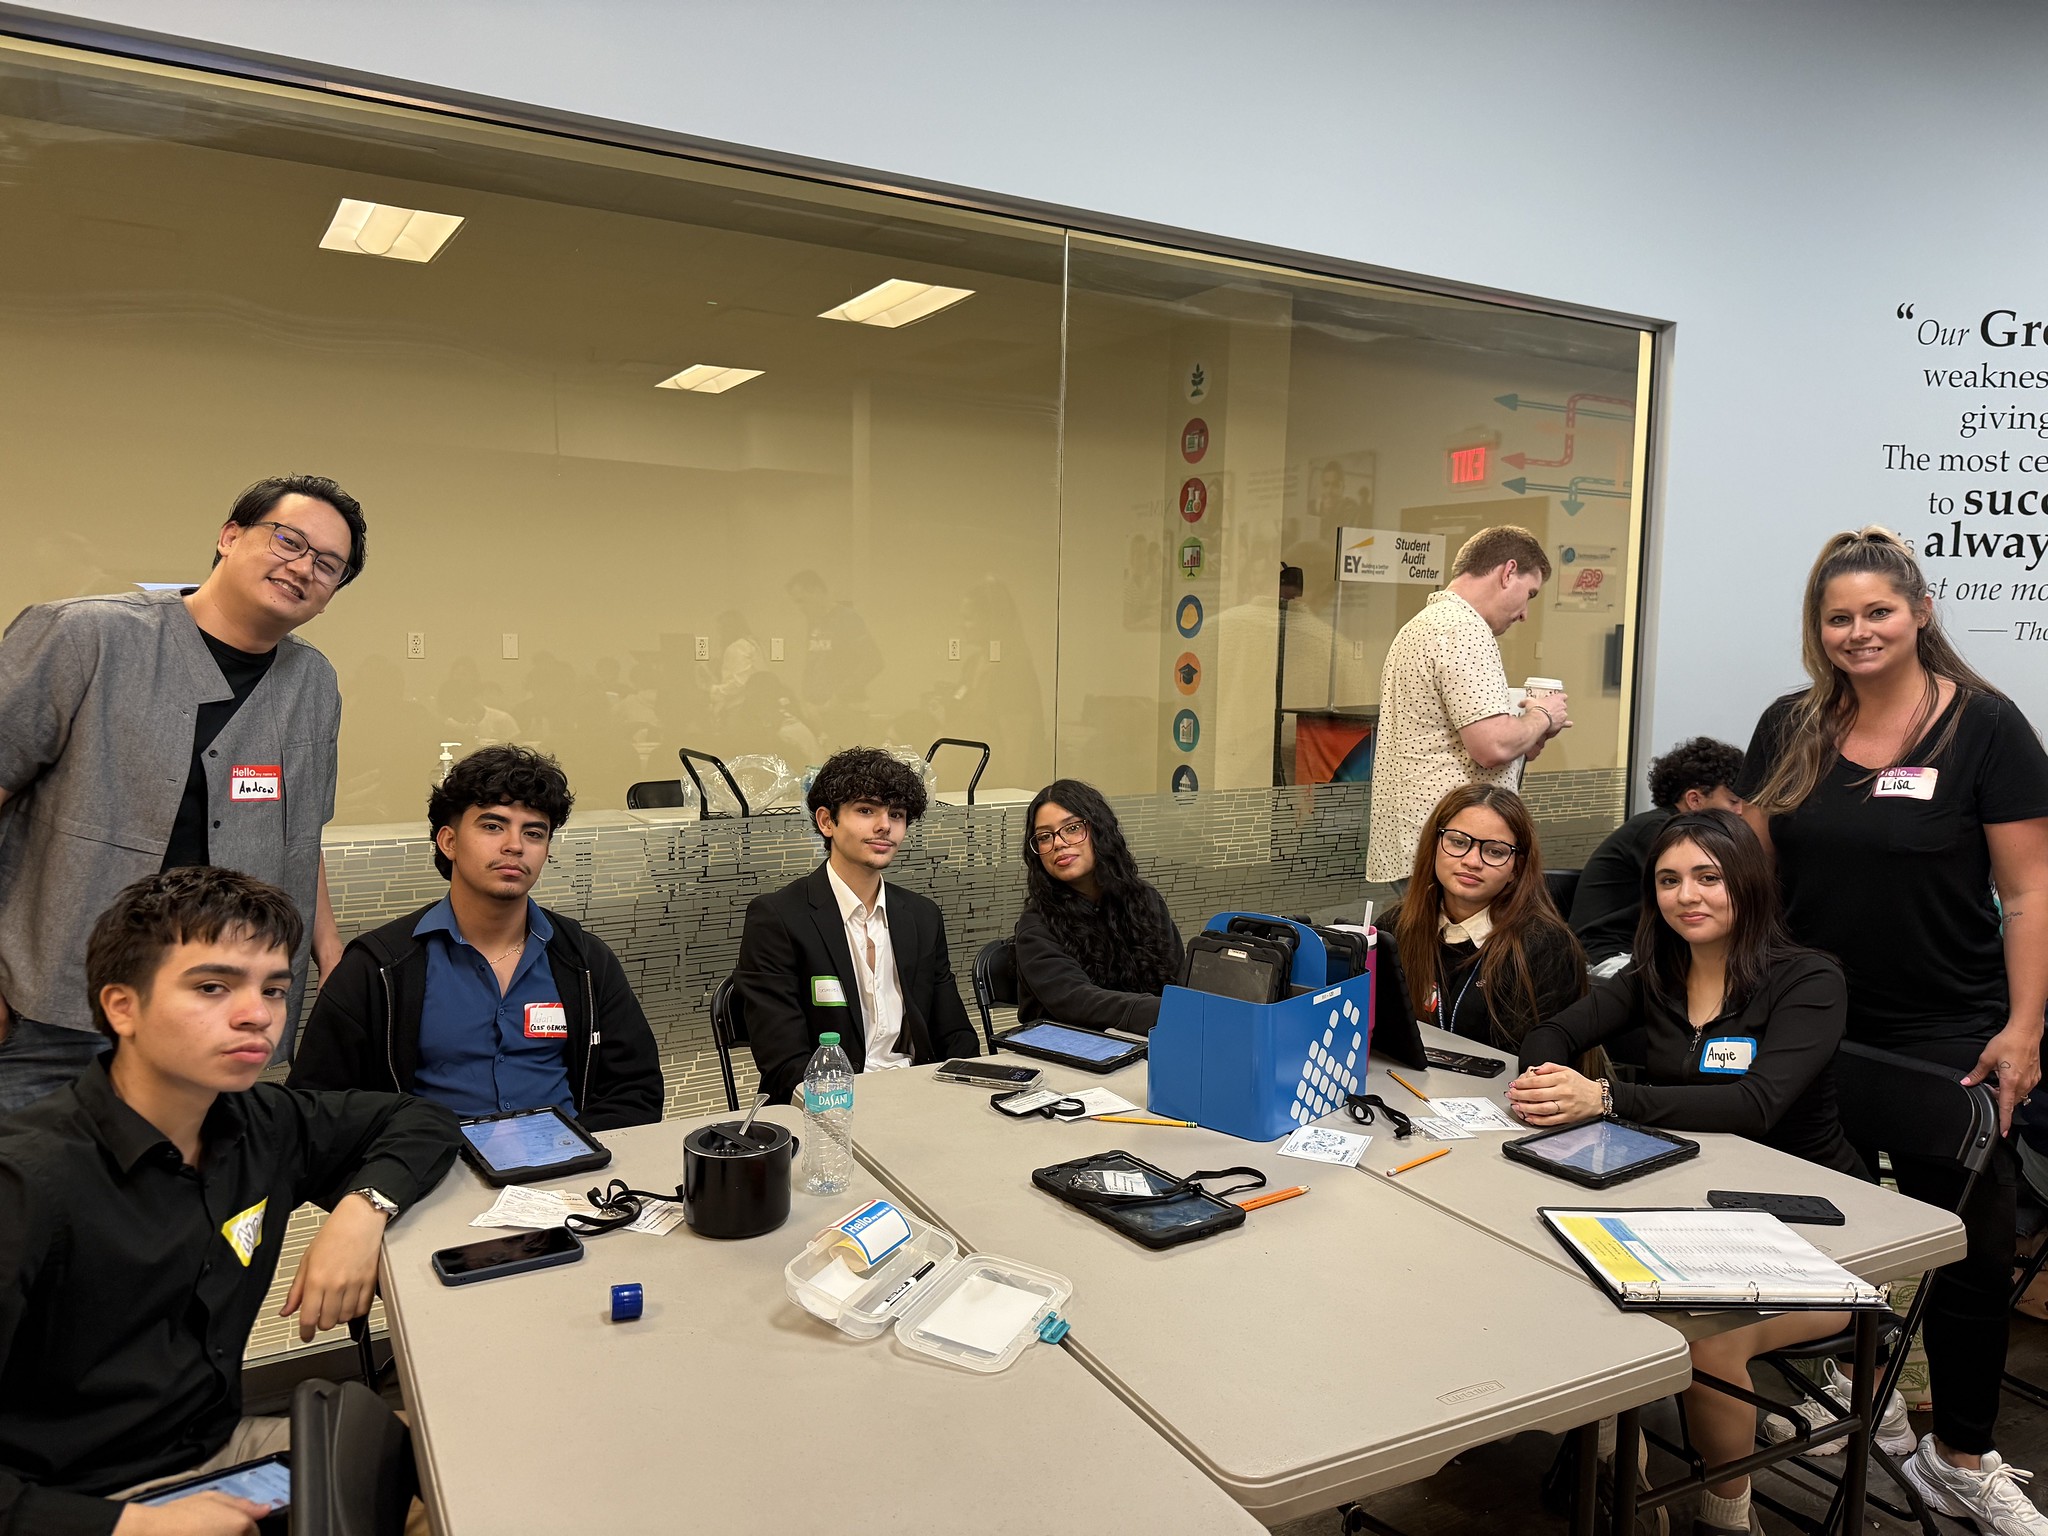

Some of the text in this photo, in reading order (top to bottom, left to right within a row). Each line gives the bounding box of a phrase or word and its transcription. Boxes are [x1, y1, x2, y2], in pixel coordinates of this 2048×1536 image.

[1980, 309, 2048, 347] Gr
[1923, 362, 2048, 389] weaknes
[1960, 404, 2048, 439] giving
[1882, 444, 1930, 471] The
[1938, 450, 2010, 472] most
[1928, 492, 1955, 515] to
[1394, 537, 1431, 552] Student
[1924, 520, 2048, 571] alway
[1343, 555, 1362, 573] EY
[1401, 552, 1426, 565] Audit
[1408, 566, 1439, 579] Center
[1955, 582, 2003, 601] one
[232, 767, 256, 777] Hello
[239, 780, 274, 794] Andrew
[1881, 777, 1915, 790] Lisa
[1707, 1046, 1737, 1069] Angie
[818, 1094, 848, 1107] DASANI
[844, 1216, 873, 1234] Hello
